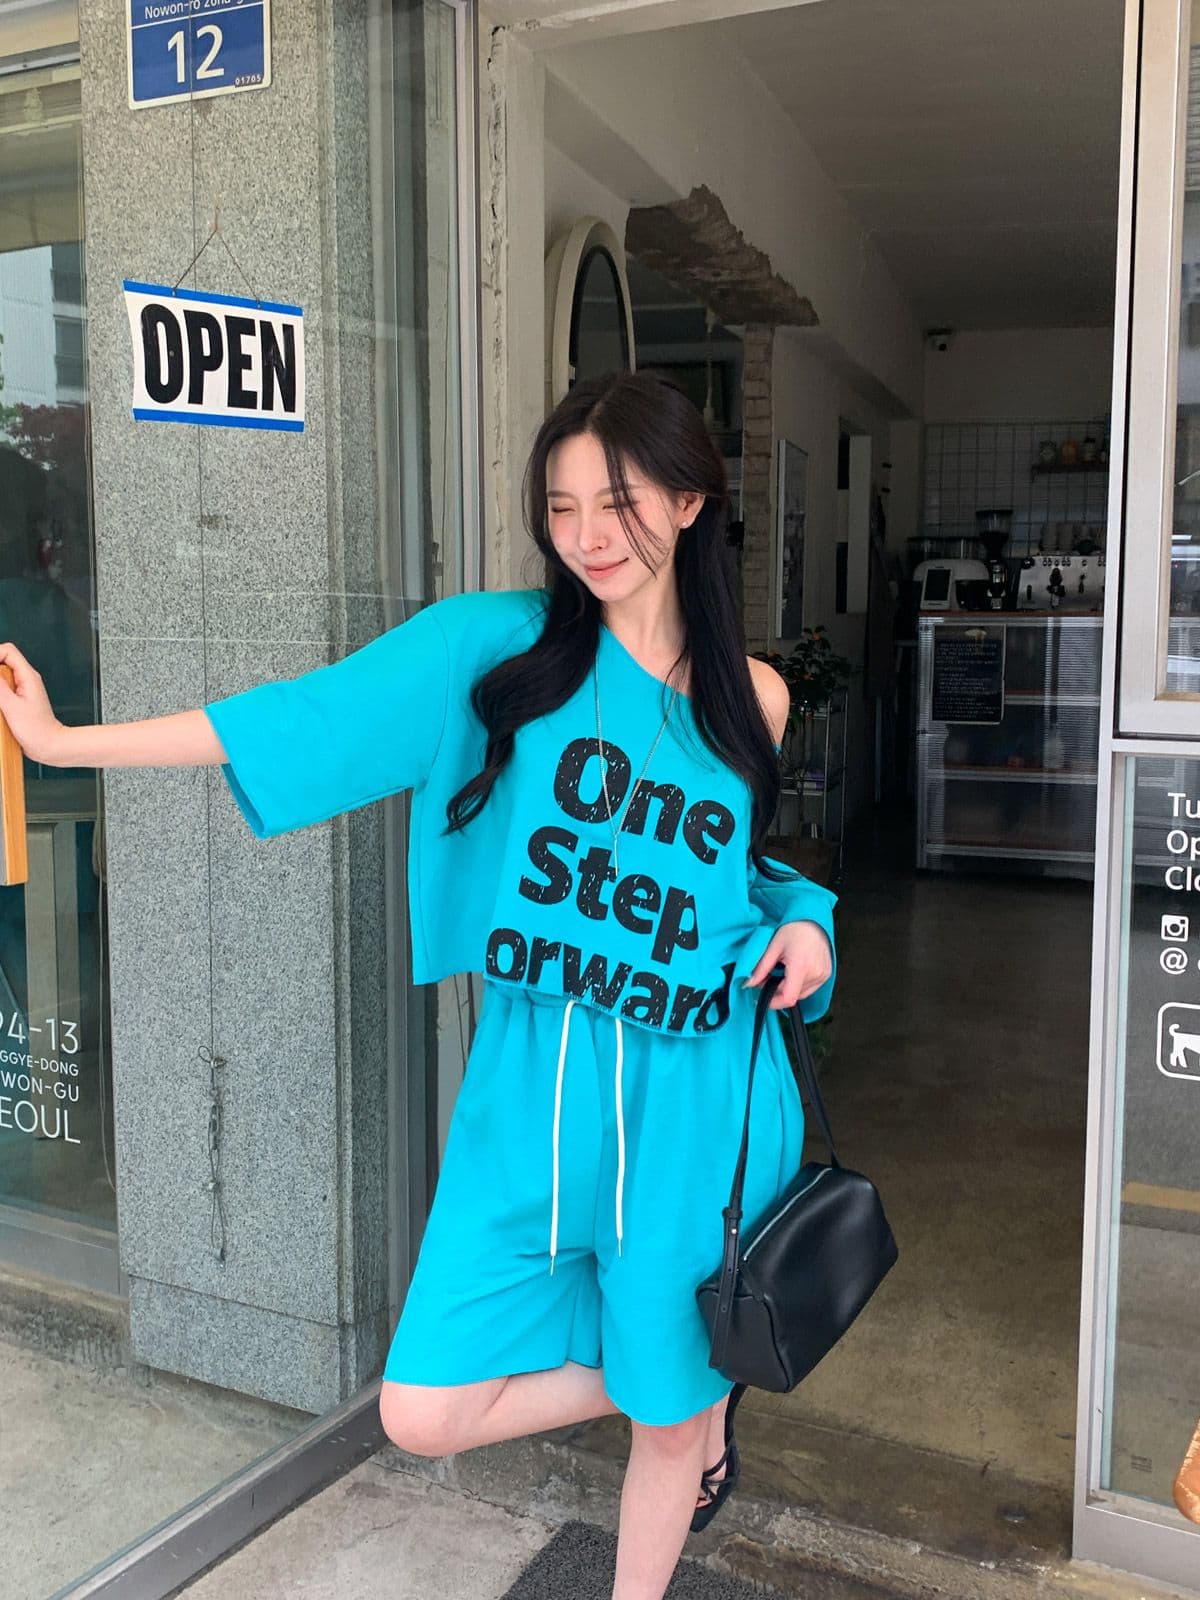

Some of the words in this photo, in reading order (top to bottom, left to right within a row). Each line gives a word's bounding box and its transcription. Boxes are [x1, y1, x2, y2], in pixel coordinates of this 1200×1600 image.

[144, 0, 201, 19] Nowon-ro
[167, 24, 225, 83] 12
[140, 303, 296, 413] OPEN
[553, 737, 736, 865] One
[518, 825, 699, 965] Step
